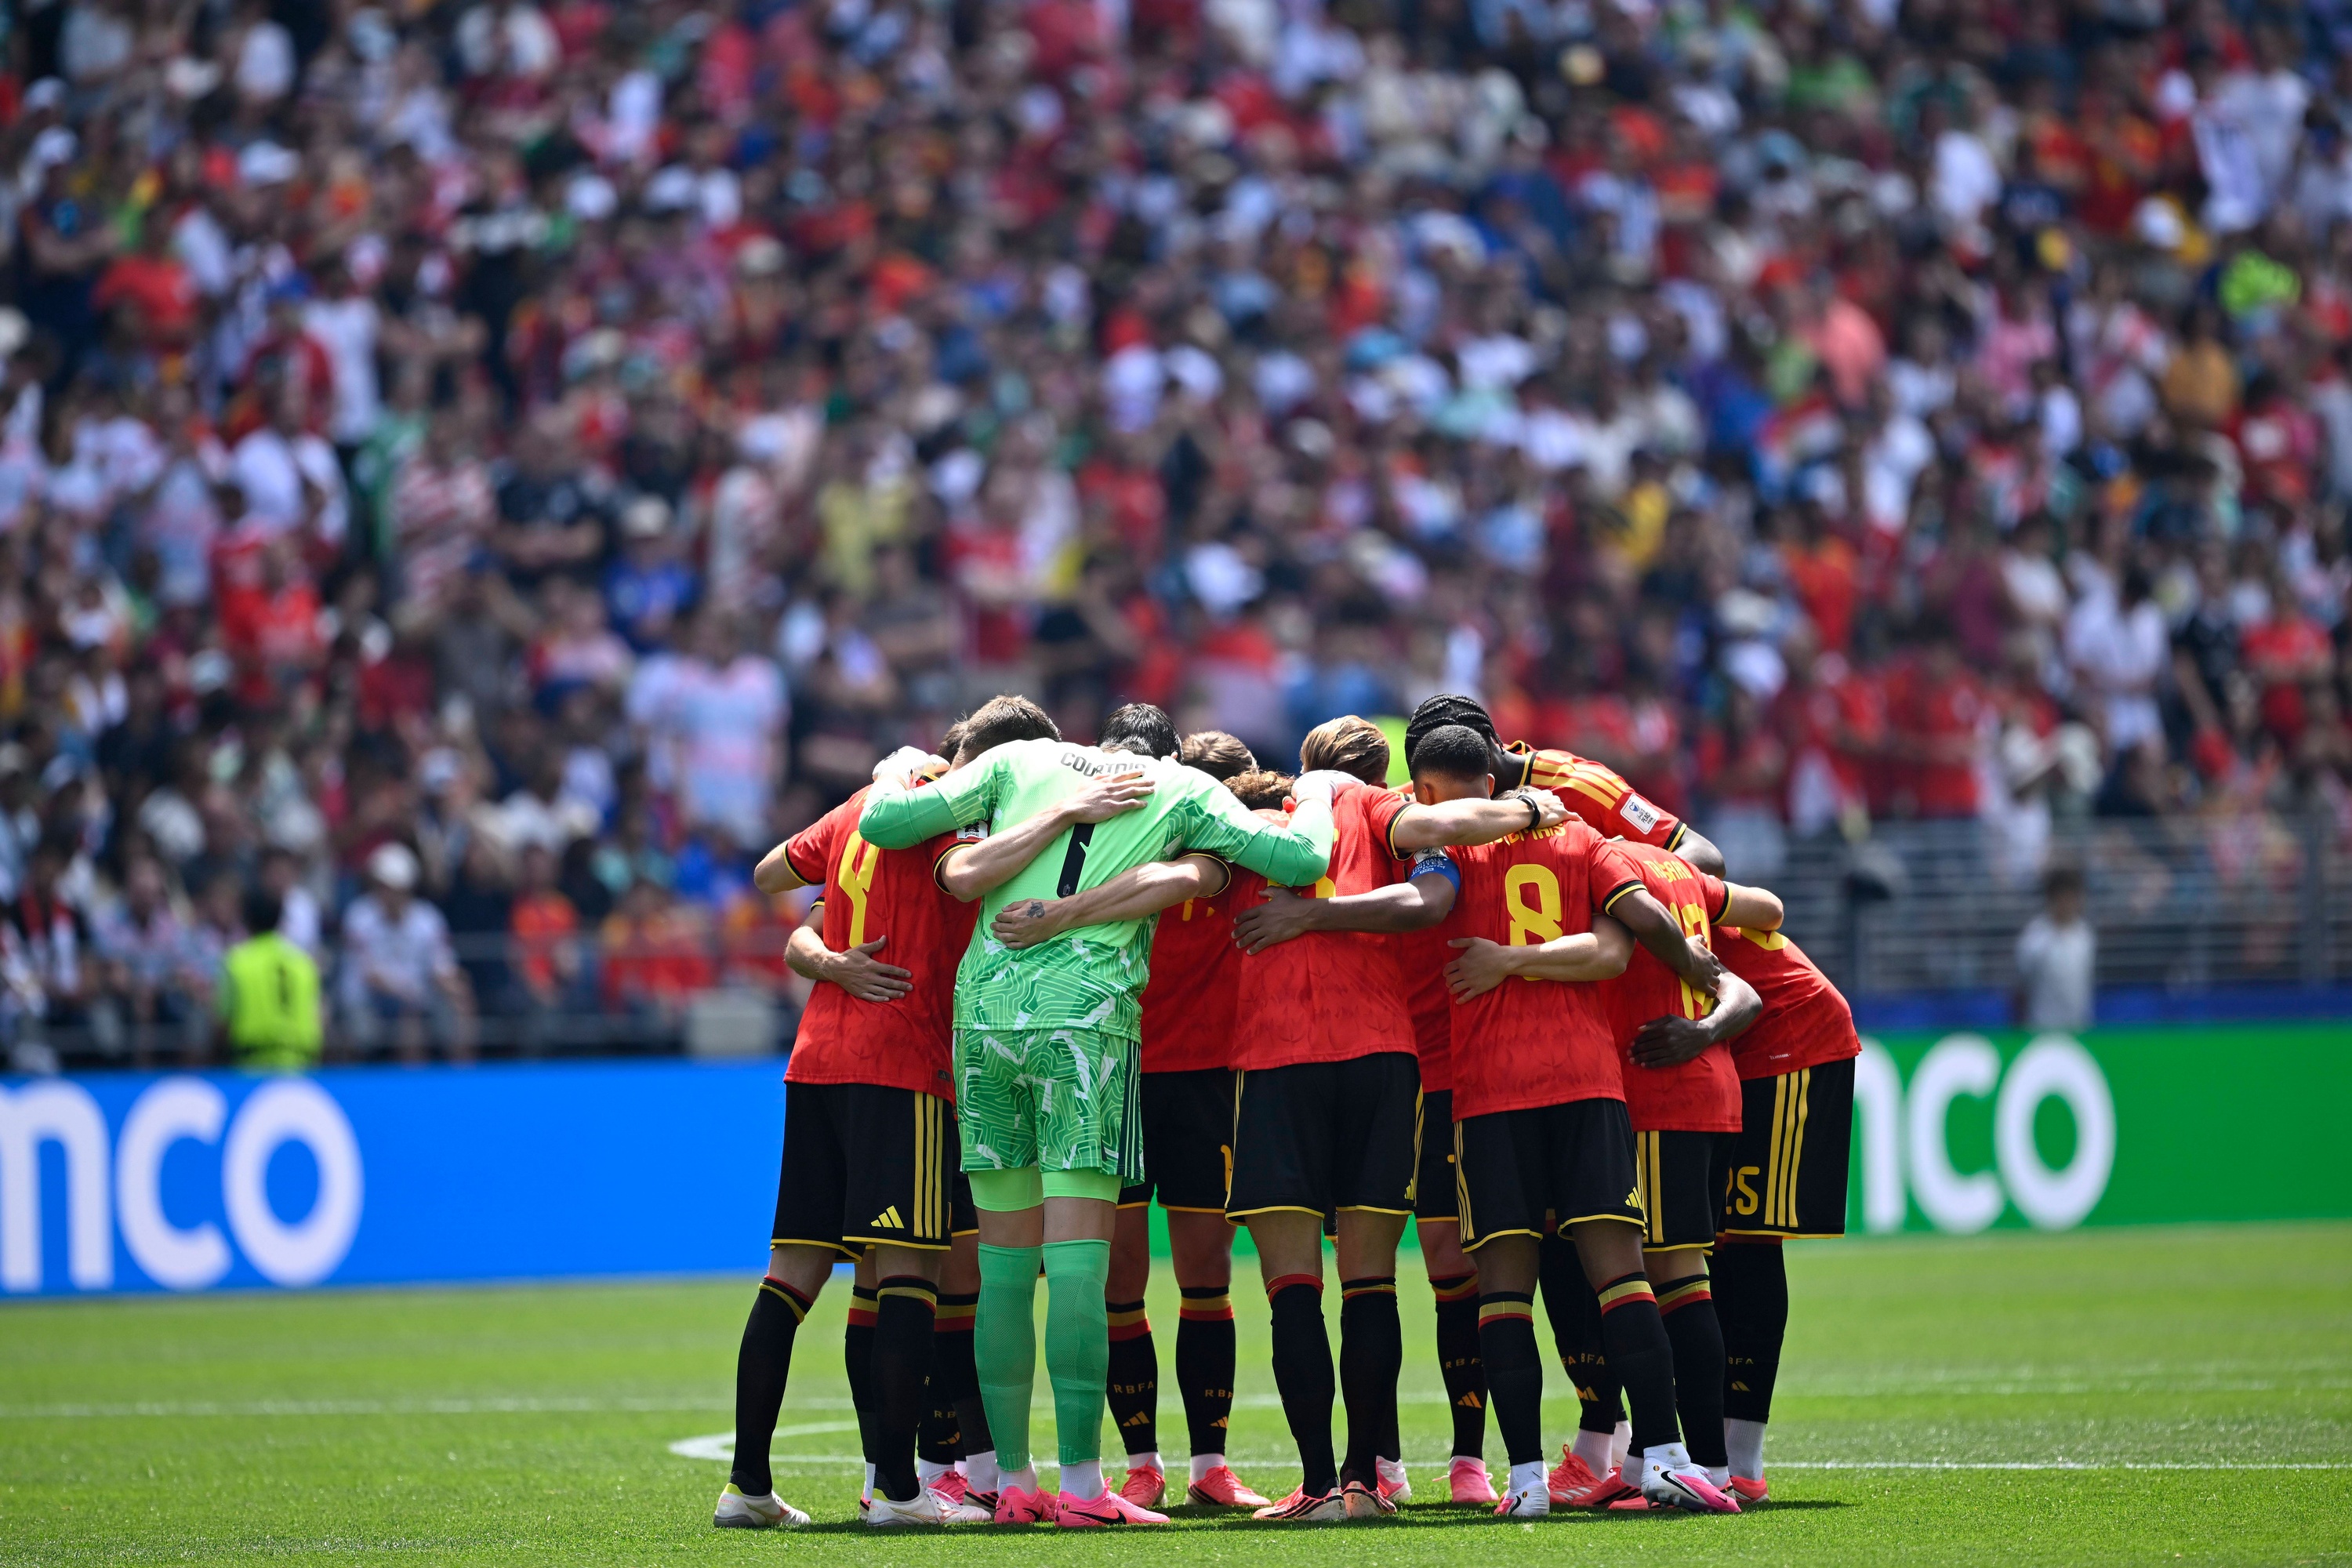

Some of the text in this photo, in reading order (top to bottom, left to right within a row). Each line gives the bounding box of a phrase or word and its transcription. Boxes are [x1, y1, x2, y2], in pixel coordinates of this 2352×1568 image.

[1504, 863, 1563, 981] 8
[1113, 1381, 1154, 1395] RBFA
[1205, 1389, 1233, 1399] RBF
